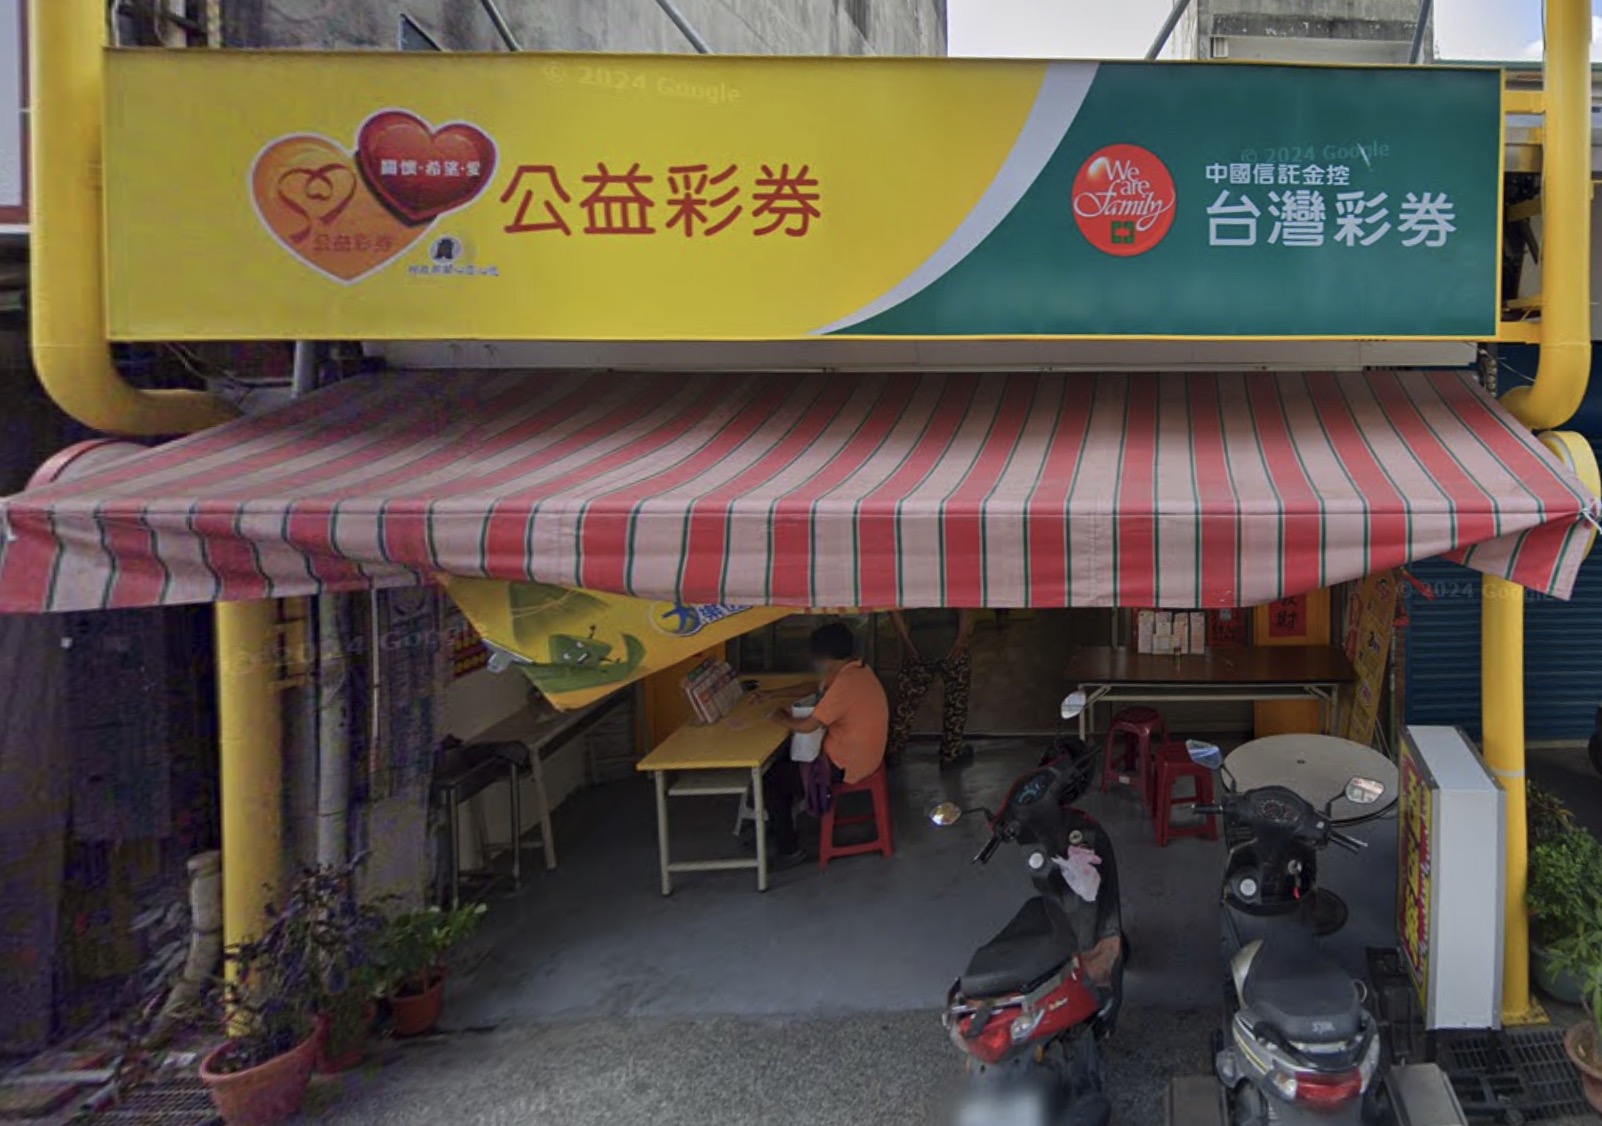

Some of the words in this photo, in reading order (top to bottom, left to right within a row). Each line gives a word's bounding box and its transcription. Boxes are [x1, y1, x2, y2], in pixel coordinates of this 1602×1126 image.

[1102, 157, 1140, 181] We
[1205, 163, 1350, 186] 中國信託金控
[500, 162, 821, 238] 公益彩券
[1120, 180, 1150, 197] are
[1205, 189, 1458, 247] 台灣彩券
[313, 231, 392, 252] 公益彩券
